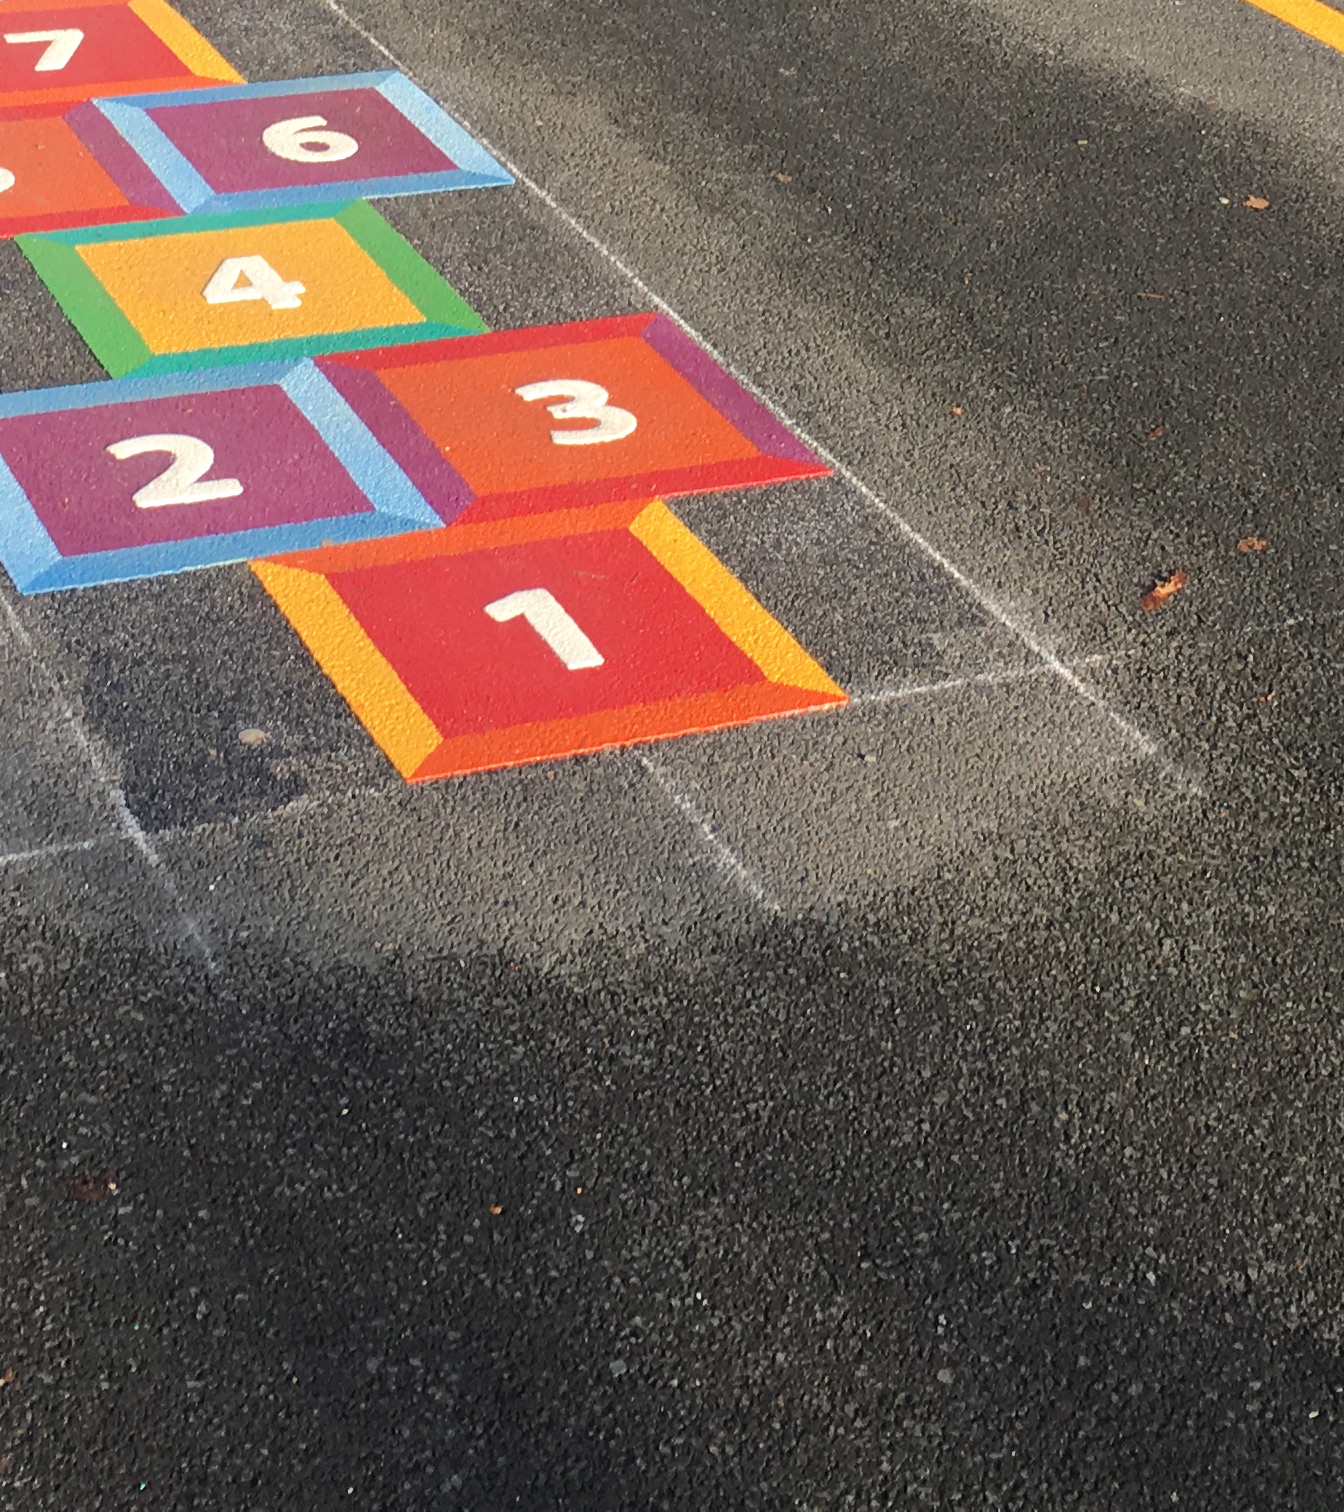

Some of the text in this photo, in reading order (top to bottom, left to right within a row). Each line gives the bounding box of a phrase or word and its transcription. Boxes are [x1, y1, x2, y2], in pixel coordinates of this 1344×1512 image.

[3, 28, 85, 72] 7
[262, 115, 359, 163] 6
[203, 255, 306, 310] 4
[515, 378, 638, 445] 3
[106, 433, 244, 509] 2
[484, 588, 605, 670] 1
